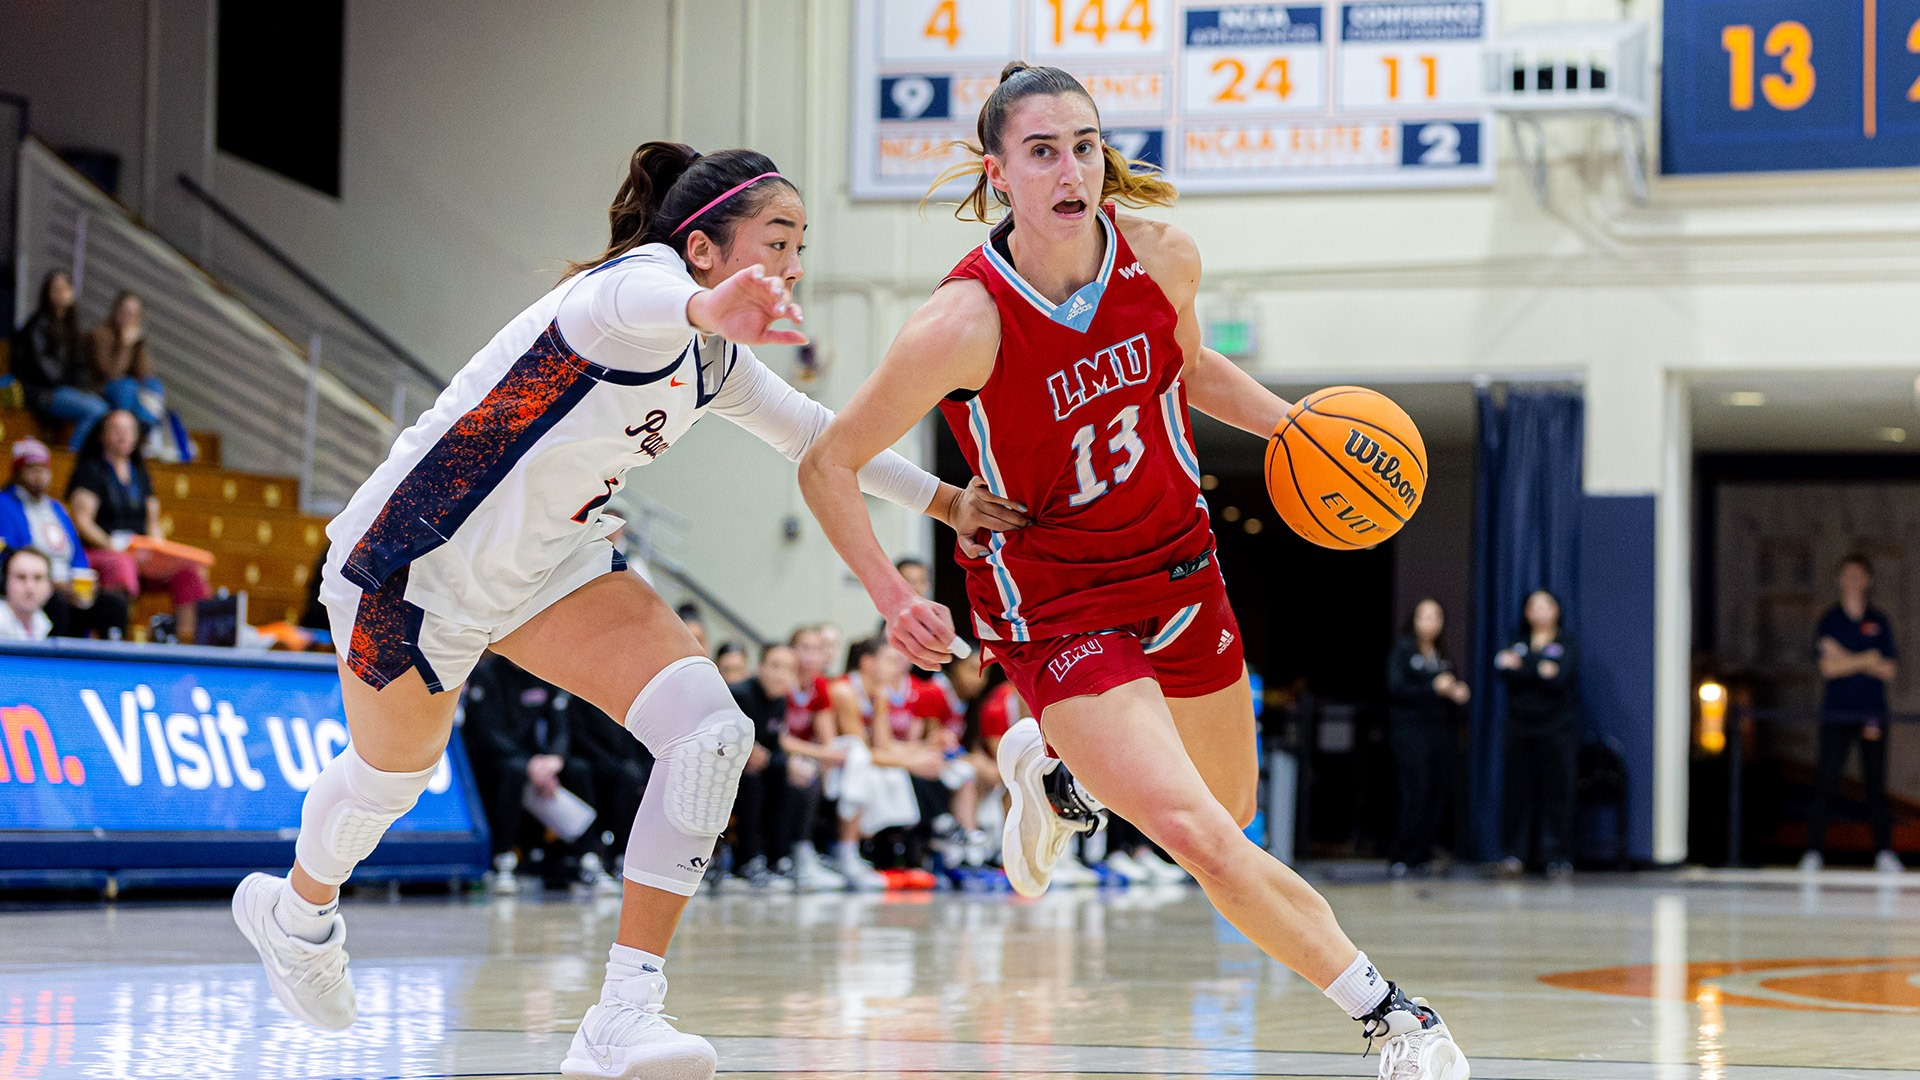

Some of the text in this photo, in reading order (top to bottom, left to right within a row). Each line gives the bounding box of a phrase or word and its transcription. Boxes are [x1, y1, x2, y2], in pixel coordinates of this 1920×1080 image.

[923, 0, 962, 47] 4
[1045, 0, 1154, 46] 144
[1210, 57, 1291, 102] 24
[1381, 56, 1438, 100] 11
[1720, 20, 1817, 111] 13
[891, 76, 935, 119] 9
[1417, 123, 1463, 165] 2
[1066, 302, 1093, 321] adidas
[1046, 332, 1150, 422] LMU
[1069, 405, 1146, 507] 13
[1344, 427, 1418, 512] Wilson
[1047, 638, 1103, 683] LMU
[80, 684, 266, 790] Visit
